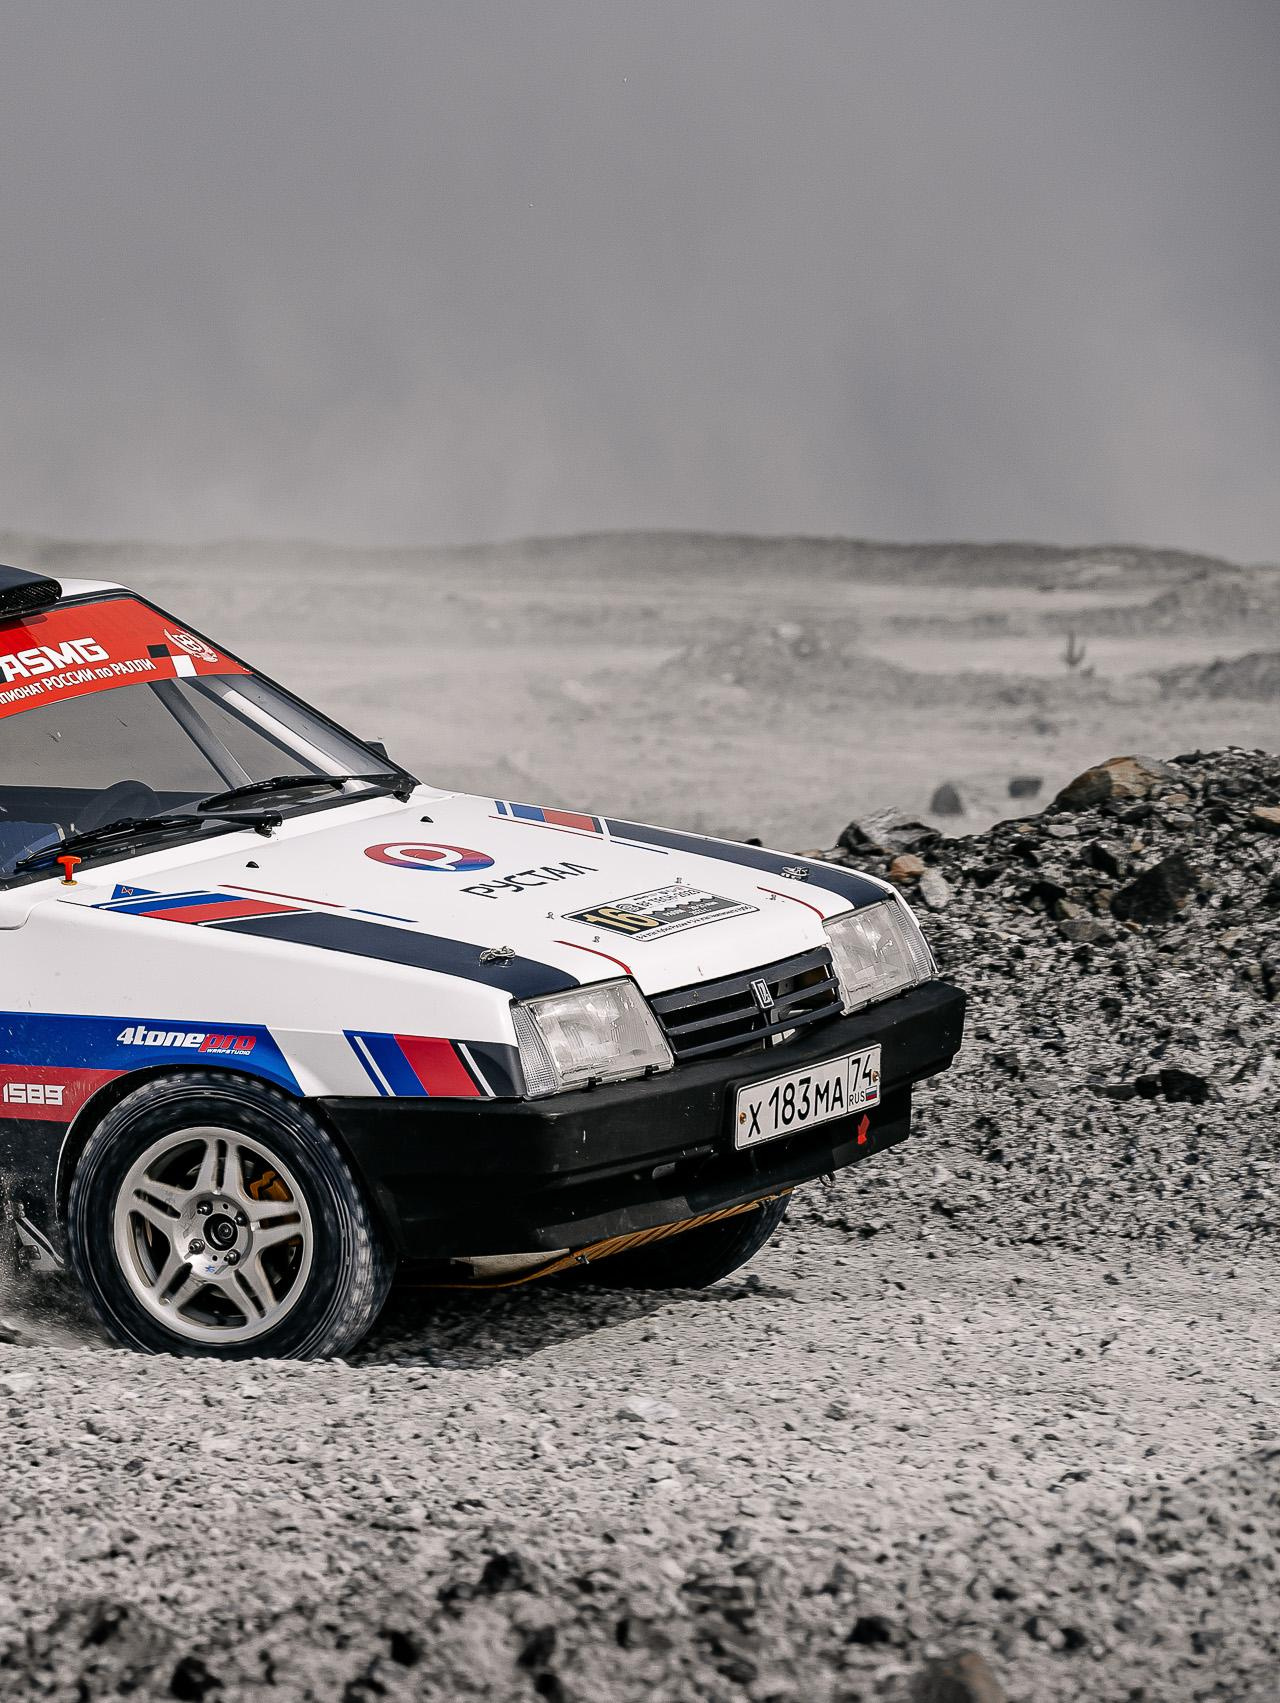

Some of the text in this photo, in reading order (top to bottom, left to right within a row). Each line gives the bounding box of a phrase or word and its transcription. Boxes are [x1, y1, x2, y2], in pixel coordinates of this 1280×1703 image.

[45, 668, 97, 690] РОССИИ
[112, 658, 157, 677] РАЛЛИ
[459, 862, 600, 899] РУСТАЛ
[583, 908, 660, 933] 16
[851, 1054, 873, 1092] 74
[848, 1091, 866, 1107] RUS
